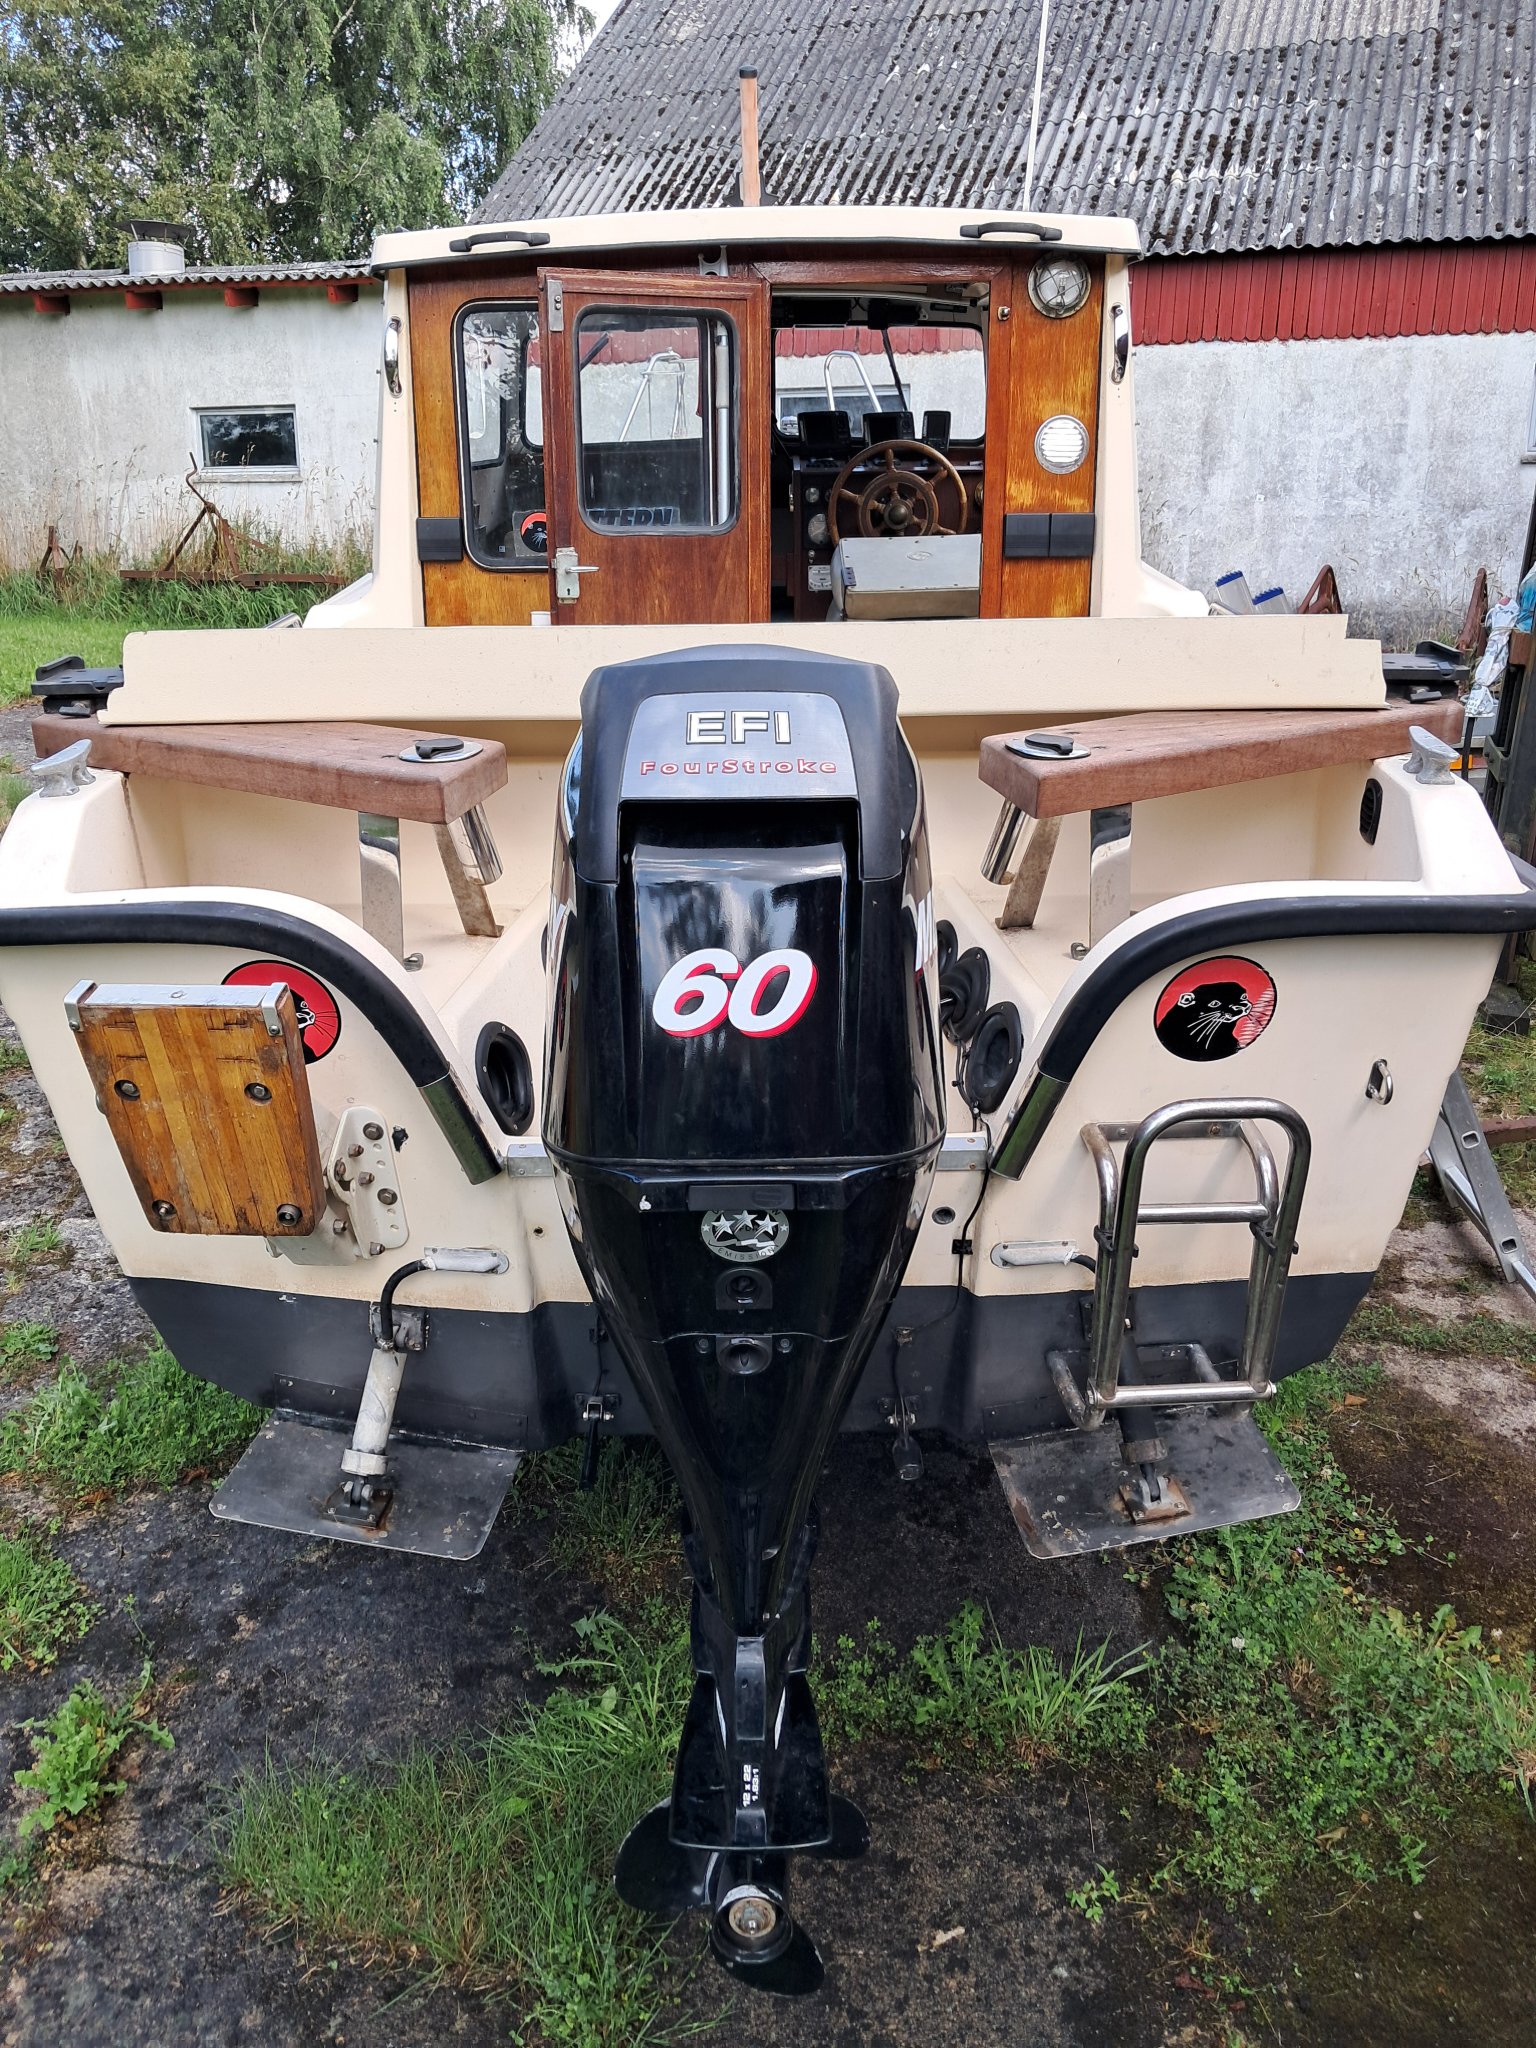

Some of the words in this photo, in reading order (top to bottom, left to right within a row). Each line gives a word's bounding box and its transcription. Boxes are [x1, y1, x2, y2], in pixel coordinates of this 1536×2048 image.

[685, 710, 791, 744] EFI
[640, 758, 836, 775] FourStroke
[652, 948, 819, 1038] 60
[717, 1246, 776, 1261] EMISSION
[743, 1764, 751, 1782] 22
[743, 1792, 751, 1808] 12
